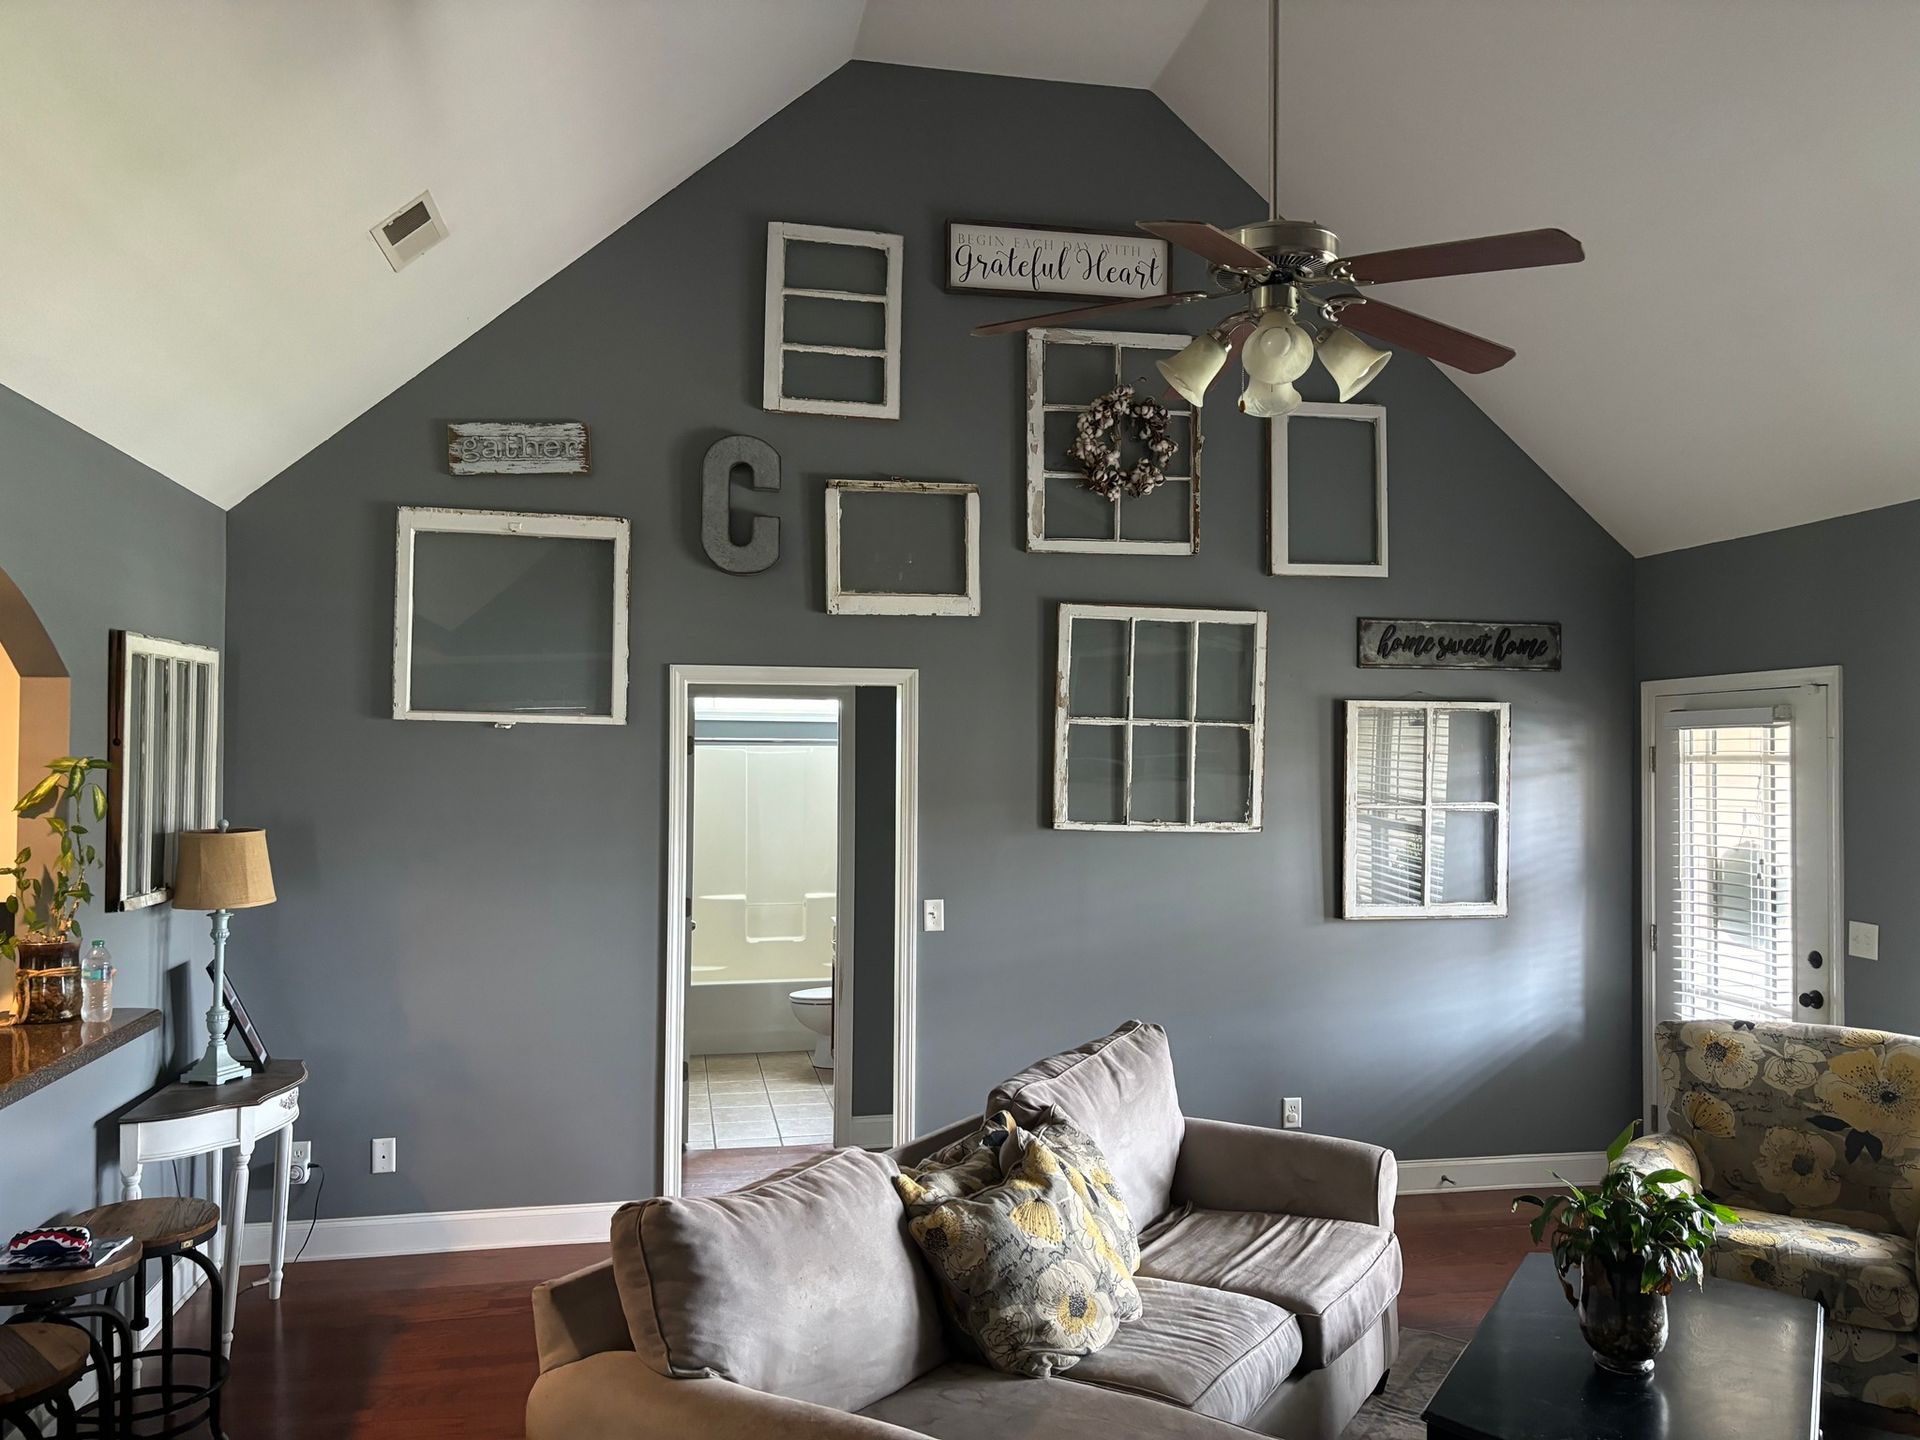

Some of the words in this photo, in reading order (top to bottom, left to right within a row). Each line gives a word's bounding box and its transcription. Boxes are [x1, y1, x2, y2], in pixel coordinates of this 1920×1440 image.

[957, 232, 1005, 247] BEGIN
[1014, 237, 1054, 251] EACH
[1101, 244, 1141, 257] WITH
[955, 244, 1071, 290] Grateful
[1076, 248, 1163, 290] Heart
[461, 434, 579, 462] gather
[701, 434, 781, 575] C
[1377, 624, 1436, 659] home
[1436, 633, 1492, 661] sweet
[1493, 628, 1549, 661] home
